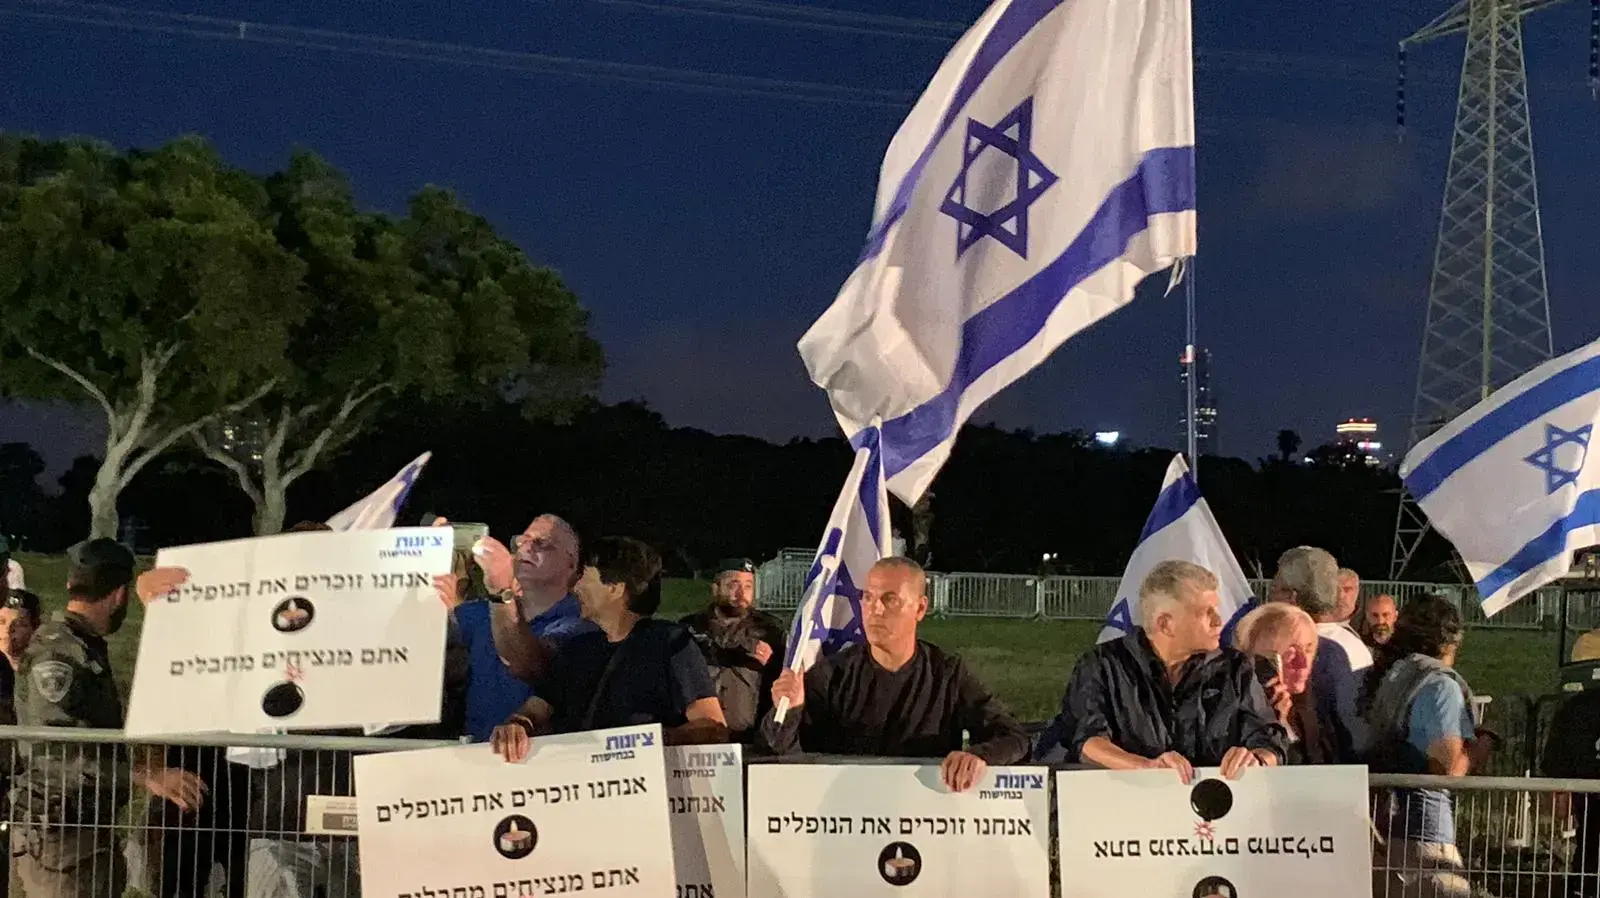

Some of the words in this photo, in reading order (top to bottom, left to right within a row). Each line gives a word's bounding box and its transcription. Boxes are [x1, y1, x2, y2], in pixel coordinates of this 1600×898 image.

[396, 536, 443, 547] ציונות
[258, 578, 286, 595] את
[295, 574, 363, 590] זוכרים
[371, 572, 429, 588] אנחנו
[167, 583, 250, 603] הנופלים
[262, 649, 352, 668] מנציחים
[361, 646, 408, 665] אתם
[170, 655, 254, 676] מחבלים
[606, 732, 654, 750] ציונות
[591, 751, 635, 763] בנחישות
[687, 752, 735, 767] ציונות
[673, 768, 716, 778] בנחישות
[995, 774, 1043, 789] ציונות
[512, 784, 579, 807] זוכרים
[588, 777, 647, 799] אנחנו
[979, 790, 1023, 799] בנחישות
[376, 798, 464, 822] הנופלים
[472, 792, 504, 812] את
[669, 796, 725, 814] אנחנו
[768, 811, 852, 834] הנופלים
[861, 817, 891, 834] את
[900, 817, 966, 835] זוכרים
[974, 818, 1031, 835] אנחנו
[1094, 840, 1141, 857] אתם
[1150, 838, 1239, 856] מנציחים
[1248, 836, 1334, 858] מחבלים
[493, 874, 584, 898] מנציחים
[592, 867, 639, 888] אתם
